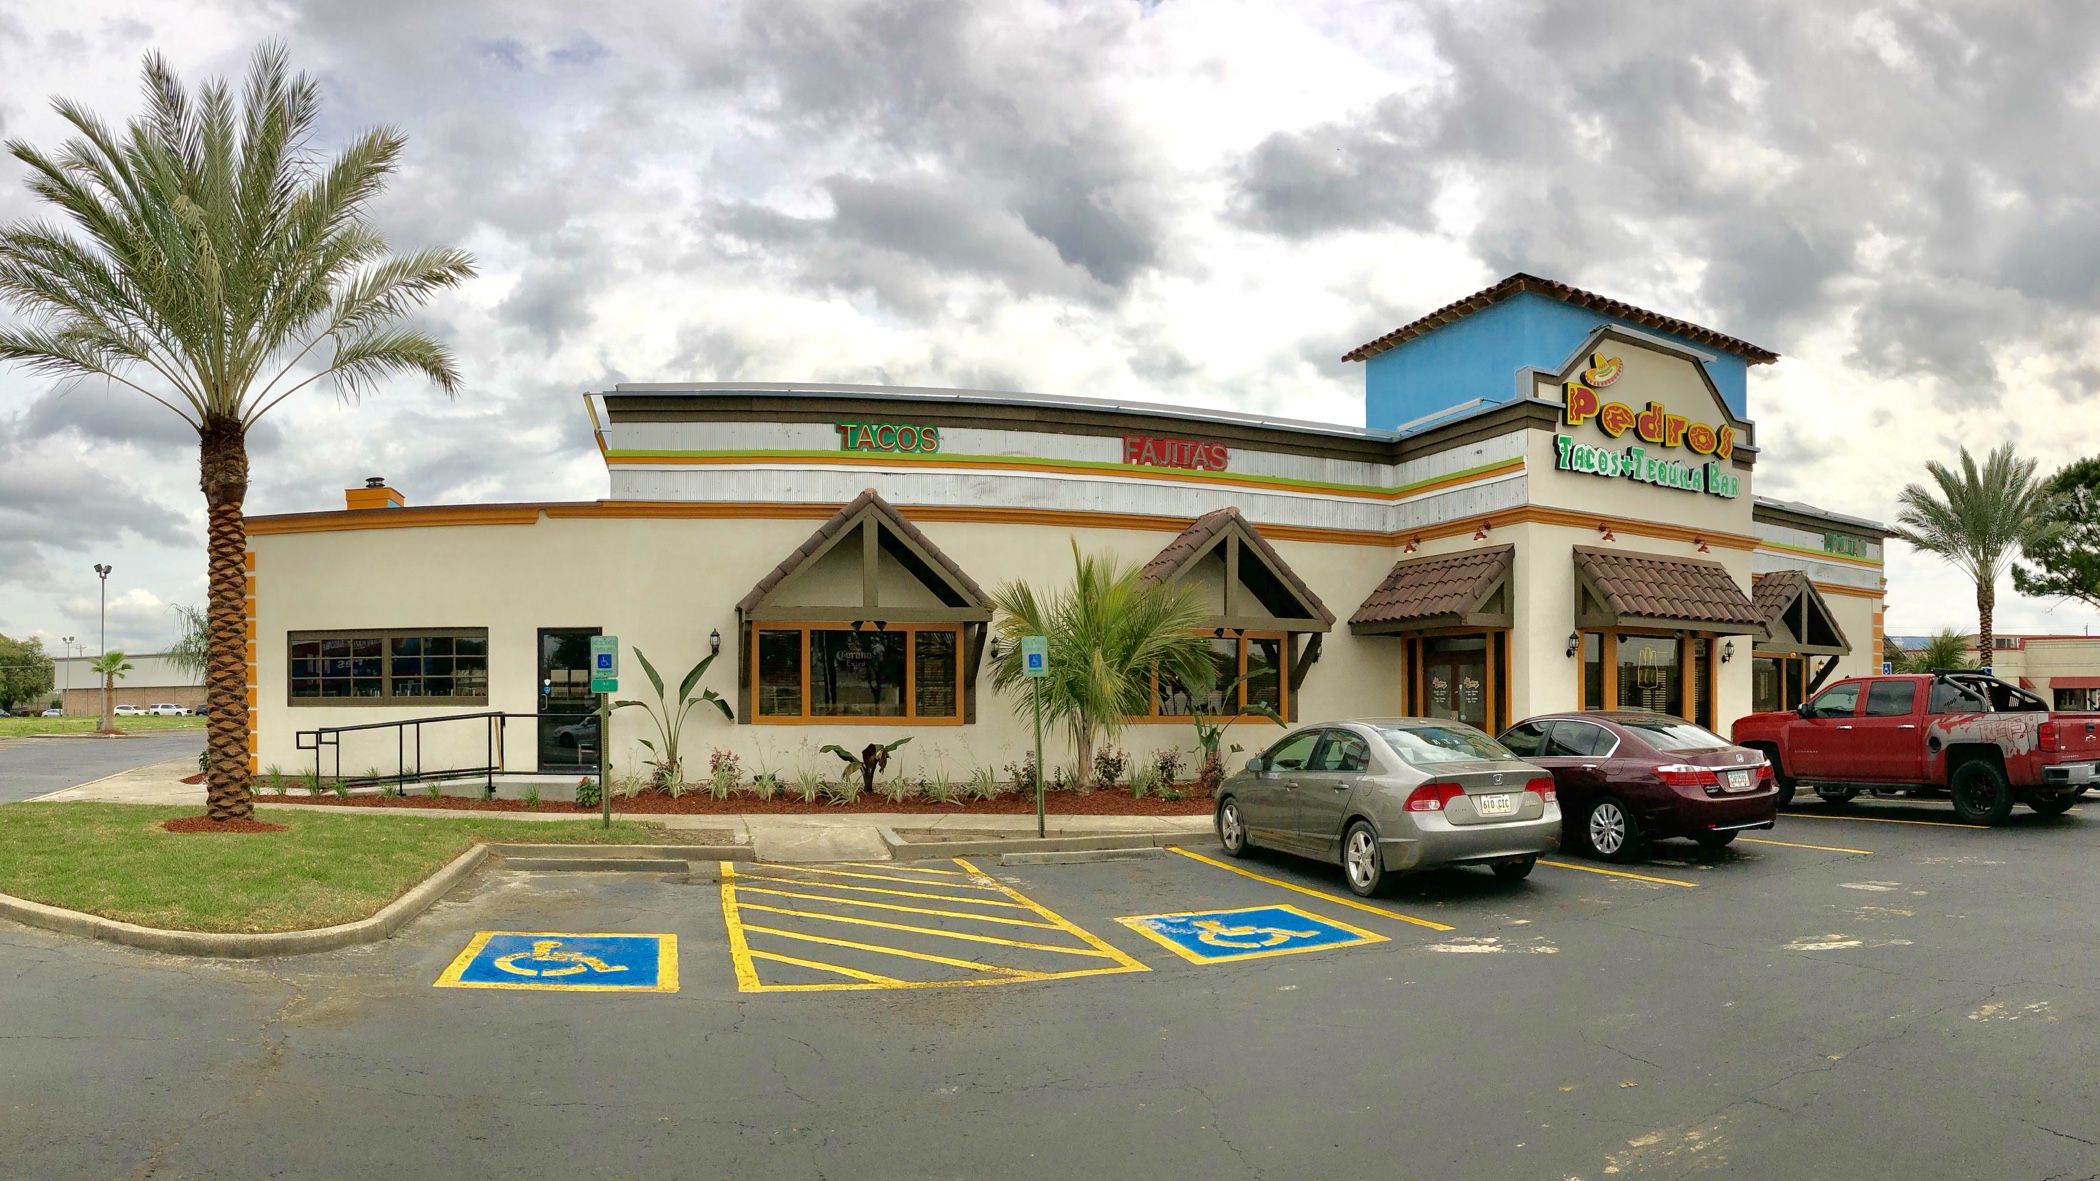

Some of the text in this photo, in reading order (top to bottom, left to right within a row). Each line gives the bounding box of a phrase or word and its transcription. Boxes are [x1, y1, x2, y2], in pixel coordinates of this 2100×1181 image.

[836, 422, 939, 453] TACOS
[1124, 436, 1228, 471] FAJITAS
[1704, 461, 1740, 498] BAR
[1824, 531, 1867, 558] FAJITAS
[835, 649, 873, 661] Corona
[1483, 798, 1510, 810] 610 CIC
